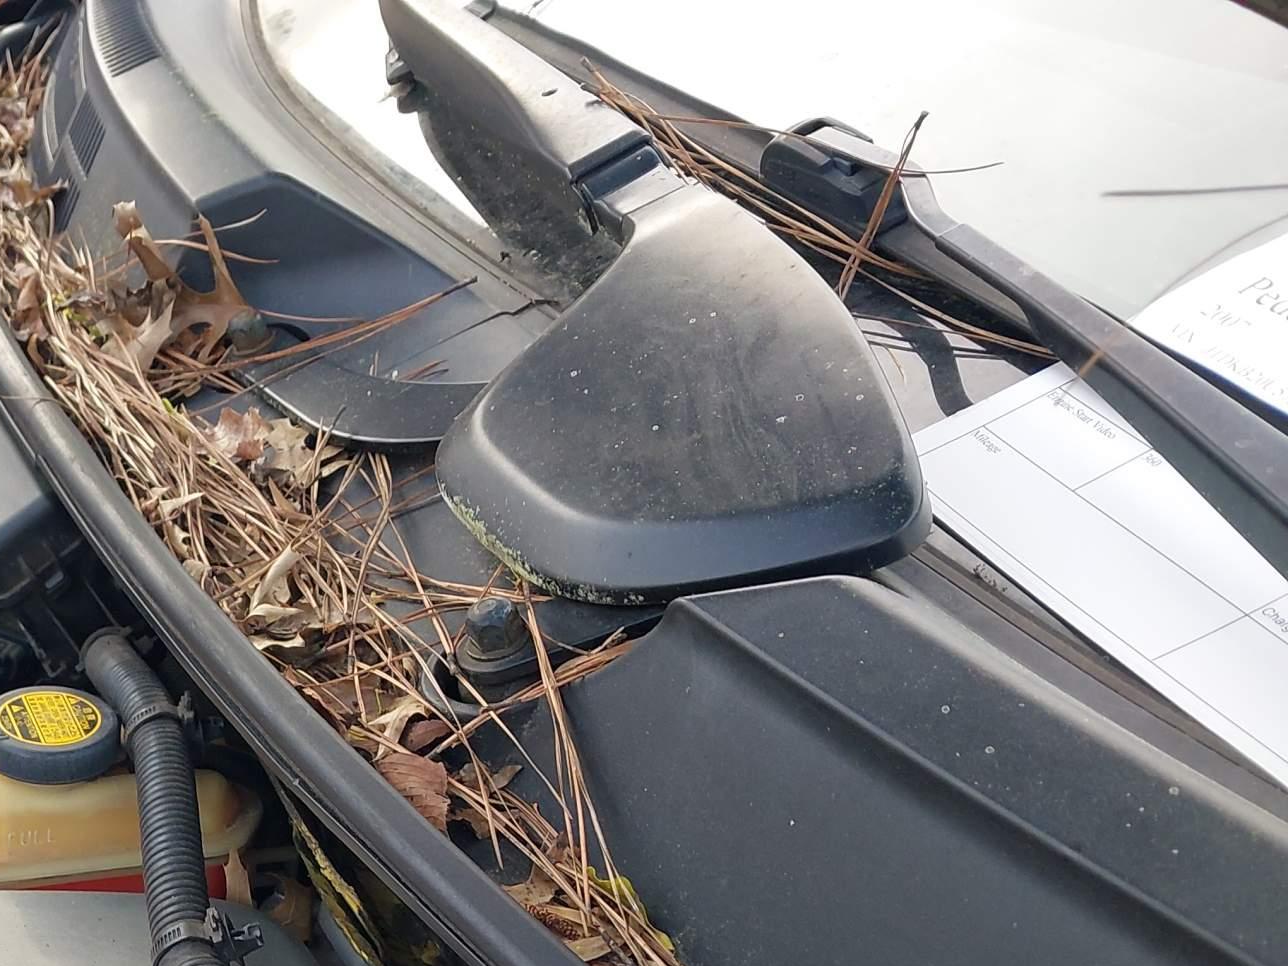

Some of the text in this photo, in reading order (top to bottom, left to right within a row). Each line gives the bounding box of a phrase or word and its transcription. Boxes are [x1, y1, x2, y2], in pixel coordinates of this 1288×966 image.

[1047, 391, 1117, 440] Engine Start Video
[972, 429, 1002, 454] Mileage
[1145, 453, 1163, 467] 360
